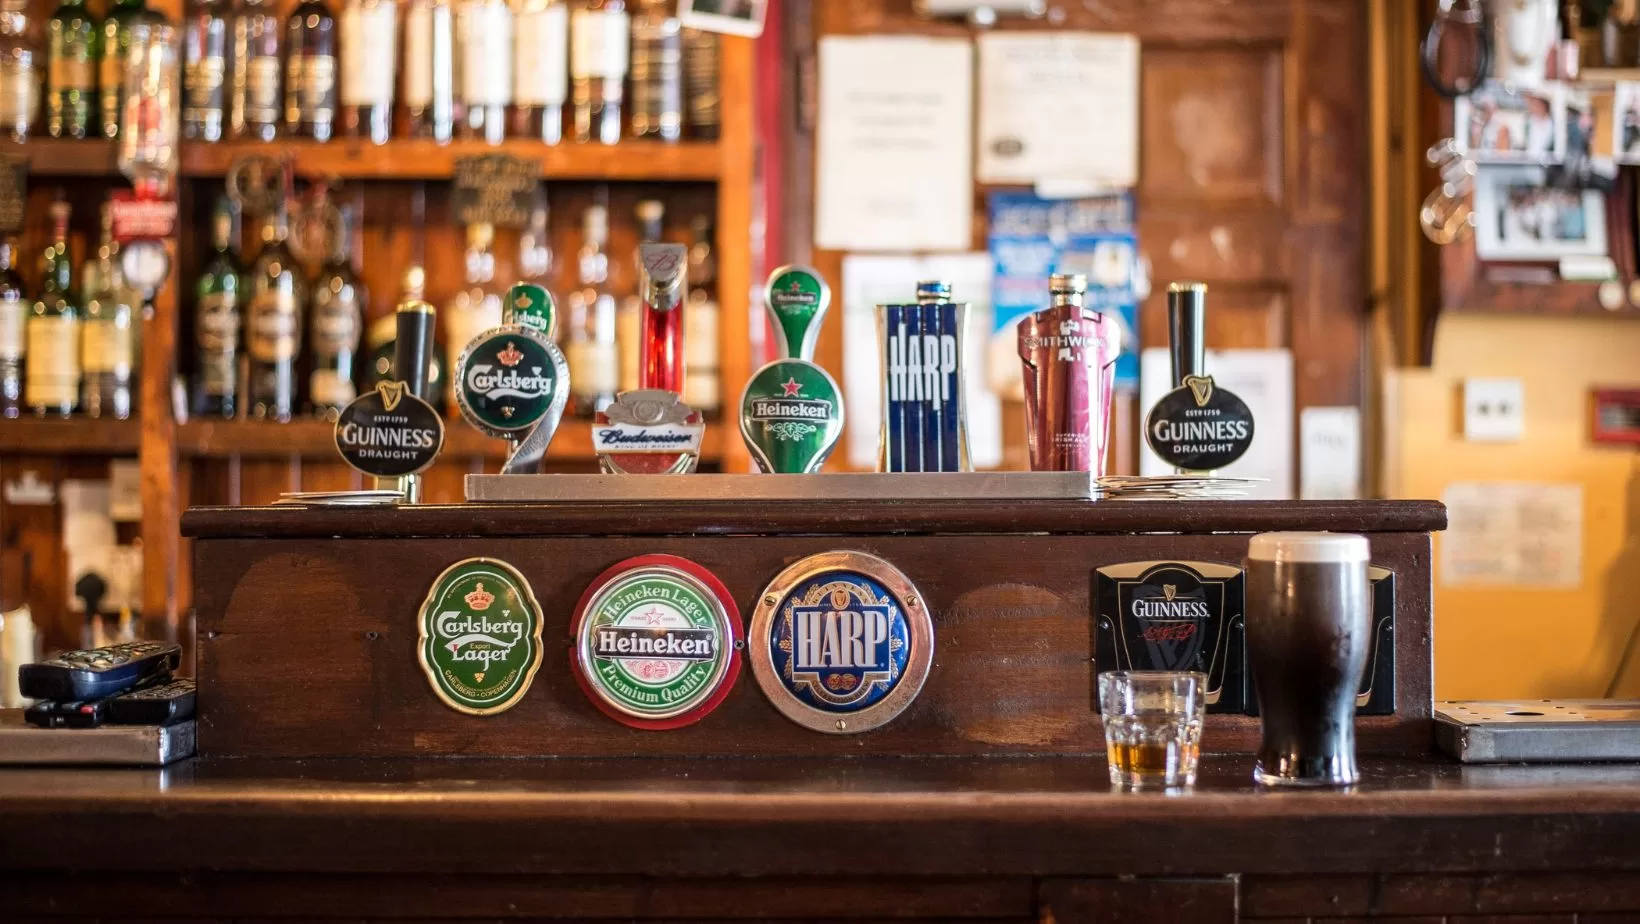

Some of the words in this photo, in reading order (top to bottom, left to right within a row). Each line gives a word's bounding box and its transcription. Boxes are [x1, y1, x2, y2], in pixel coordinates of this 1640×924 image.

[890, 322, 956, 411] HARP
[467, 364, 553, 399] Carlsberg
[757, 403, 827, 418] Heineken
[343, 422, 434, 448] GUINNESS
[599, 429, 692, 444] Budweiser
[1154, 420, 1248, 441] GUINNESS
[359, 449, 419, 460] DRAUGHT
[1173, 443, 1234, 454] DRAUGHT
[602, 584, 670, 620] Heineken
[672, 589, 708, 624] Lager
[1132, 599, 1208, 618] GUINNESS
[437, 611, 523, 646] Carlsberg
[796, 610, 887, 668] HARP
[599, 631, 711, 655] Heineken
[452, 647, 512, 672] Lager
[603, 664, 659, 703] Premium
[661, 666, 708, 703] Quality
